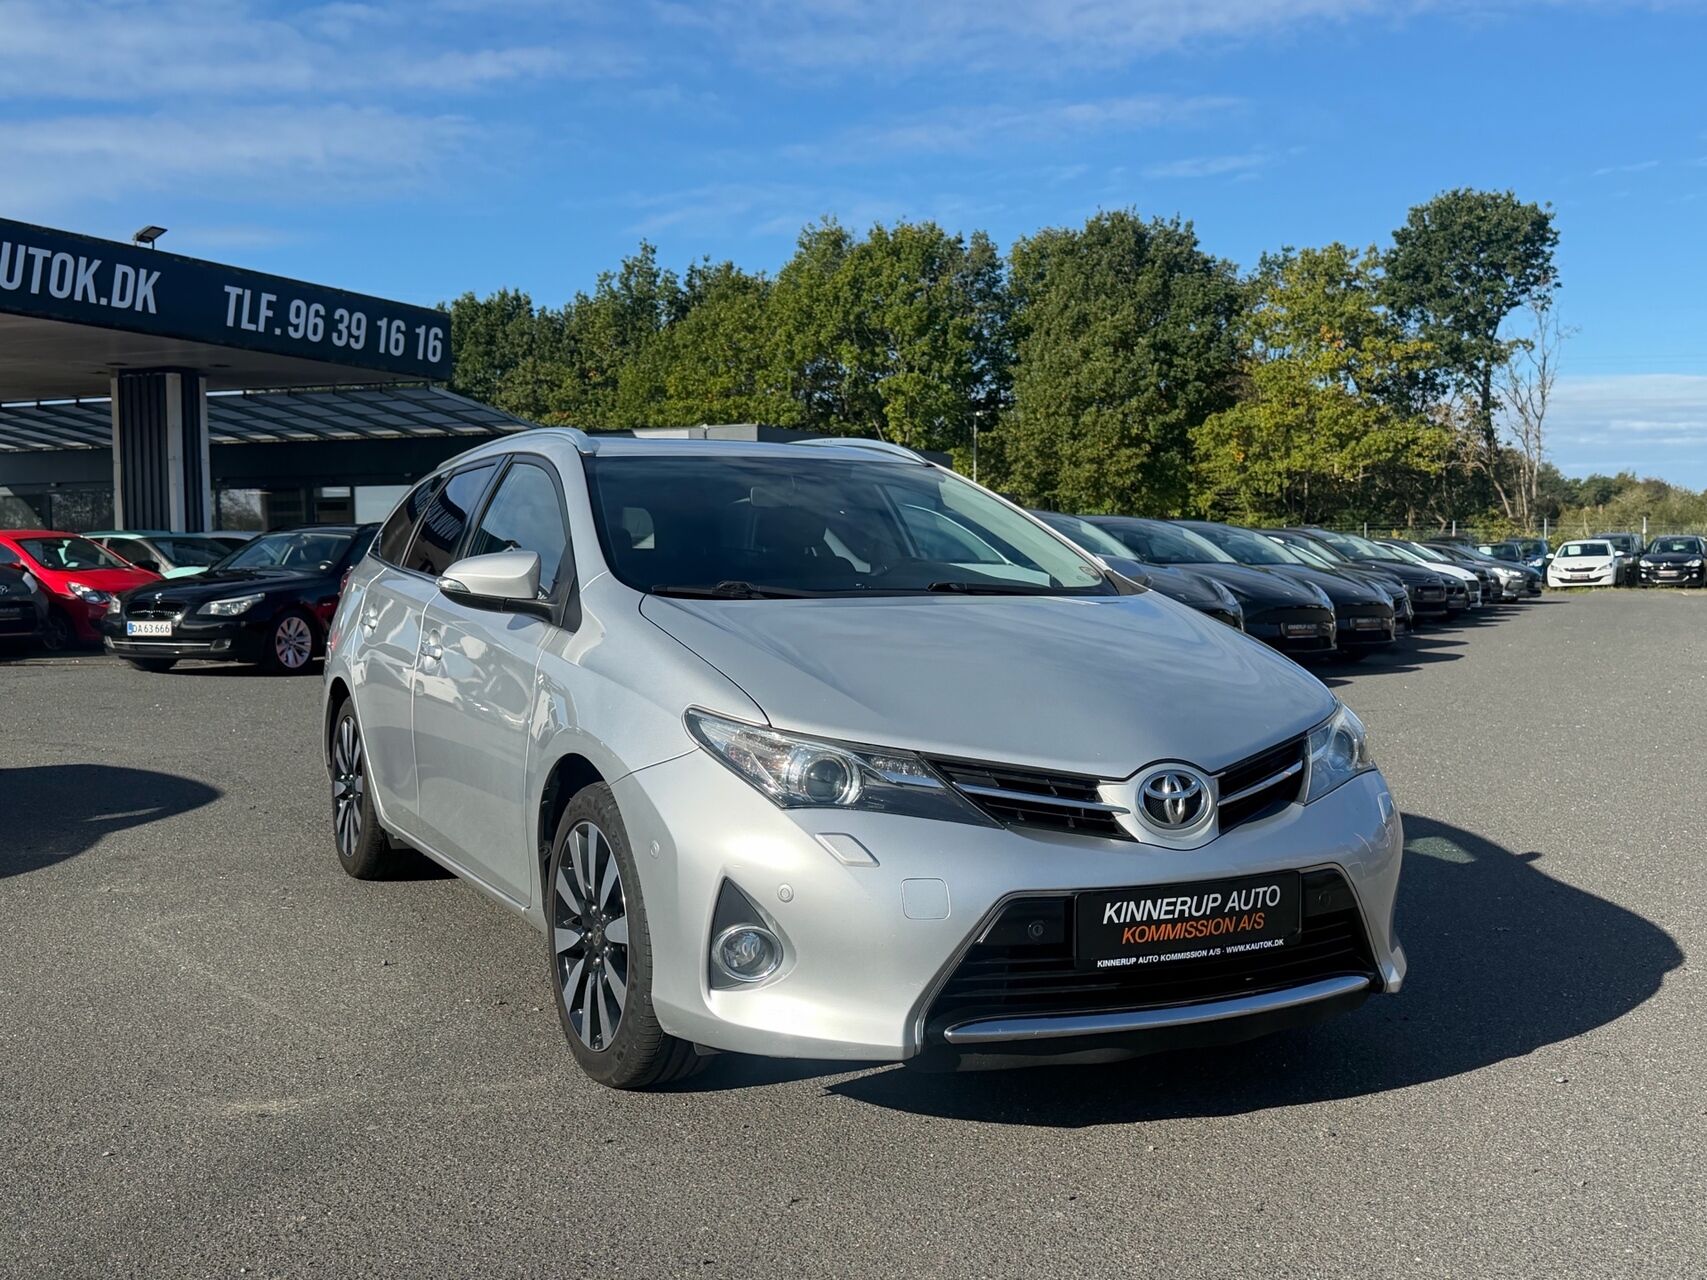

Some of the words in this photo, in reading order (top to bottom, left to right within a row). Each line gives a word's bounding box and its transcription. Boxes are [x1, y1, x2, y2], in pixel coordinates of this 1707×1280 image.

[0, 240, 162, 314] UTOK.DK
[224, 285, 281, 335] TLF.
[287, 299, 325, 342] 96
[331, 308, 367, 350] 39
[376, 317, 406, 356] 16
[415, 324, 443, 363] 16
[132, 624, 143, 633] DA
[143, 624, 154, 633] 63
[154, 624, 170, 633] 666
[1103, 893, 1222, 924] KINNERUP
[1224, 885, 1280, 913] AUTO
[1122, 916, 1236, 944] KOMMISSION
[1237, 913, 1265, 932] A/S
[1097, 957, 1137, 968] KINNERUP
[1138, 954, 1159, 963] AUTO
[1160, 949, 1208, 962] KOMMISSION
[1208, 948, 1222, 956] A/S
[1226, 938, 1285, 953] WWW.KAUTOK.DK
